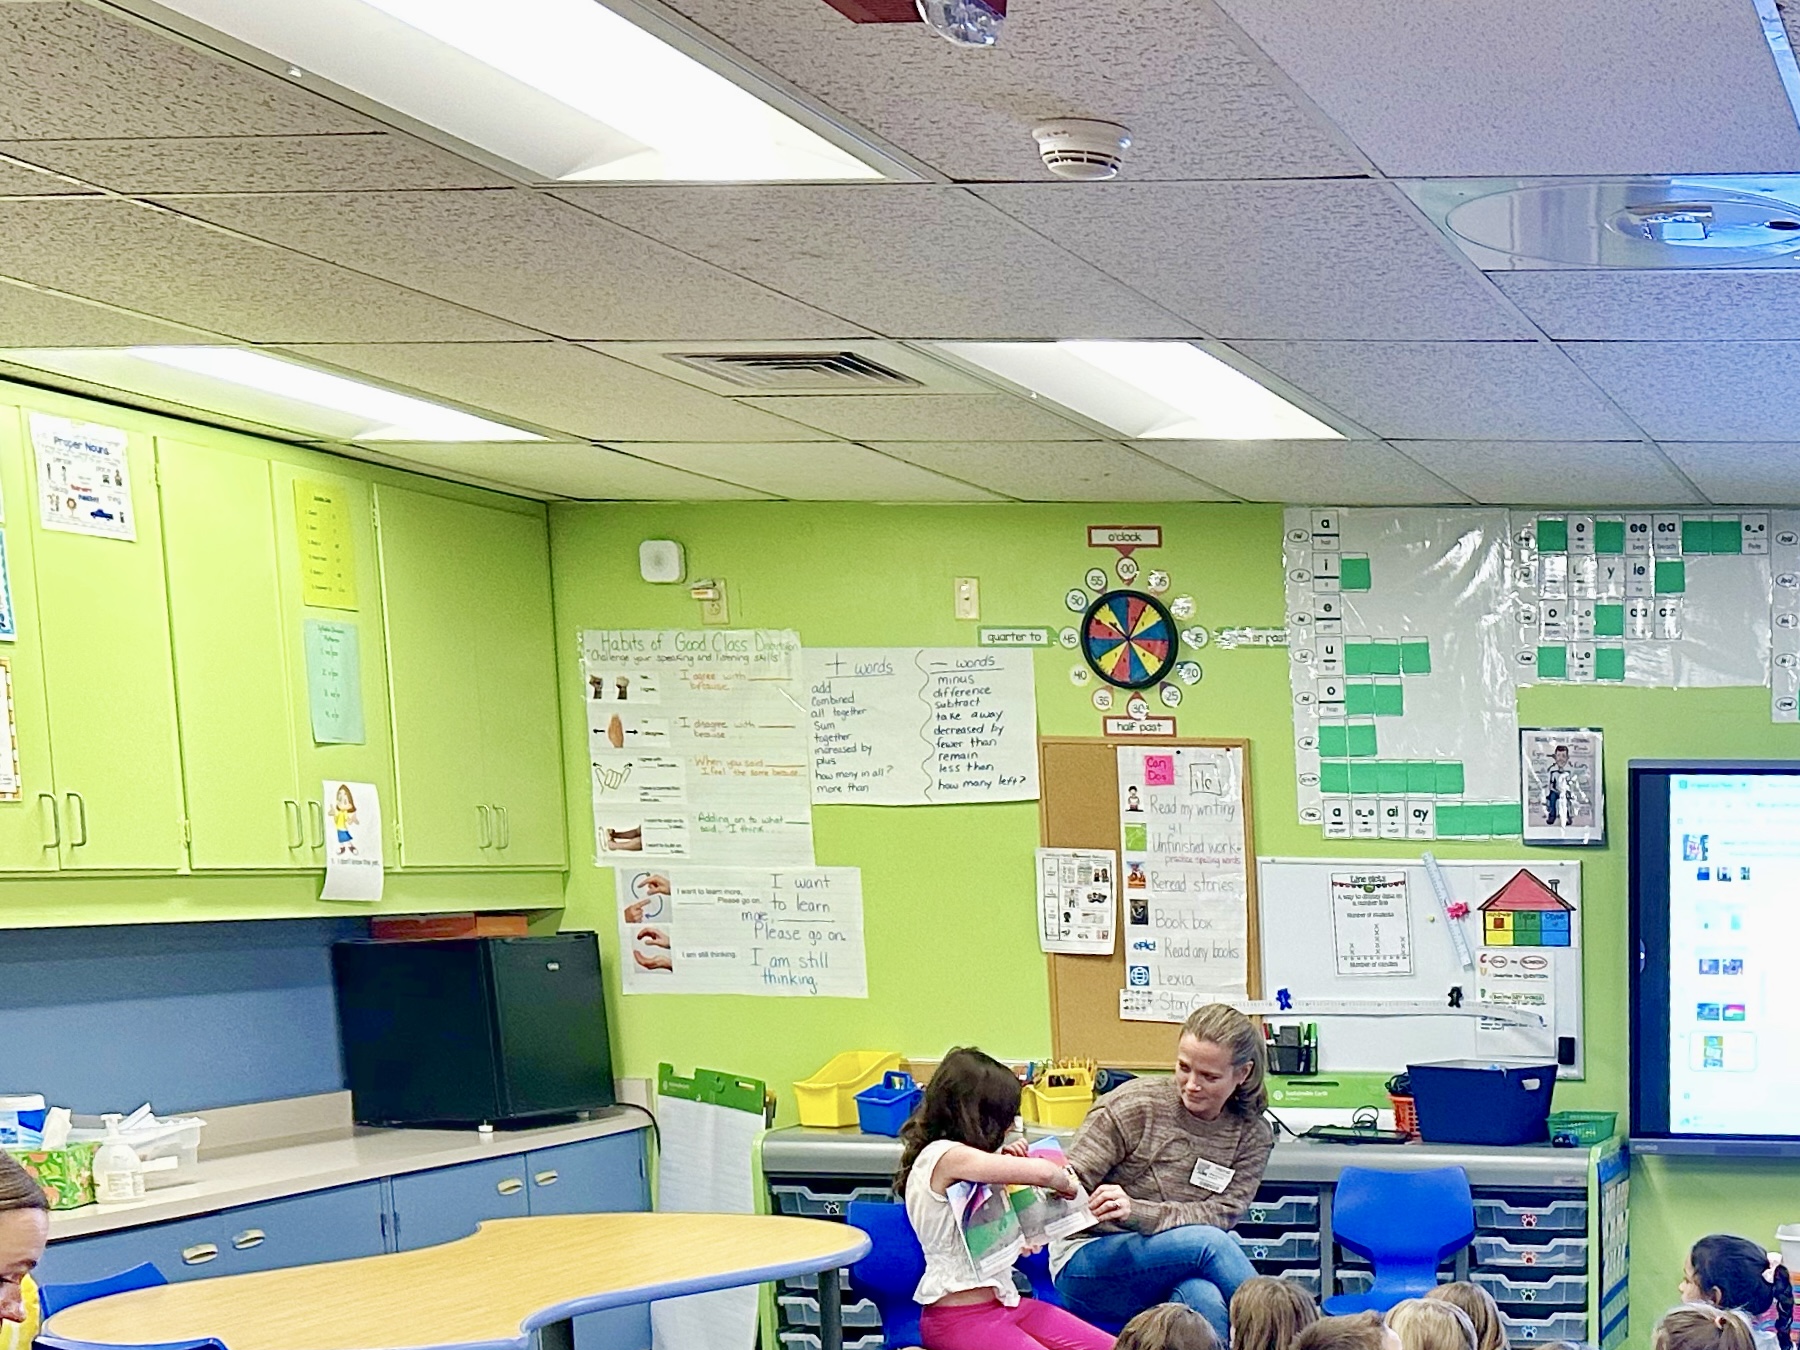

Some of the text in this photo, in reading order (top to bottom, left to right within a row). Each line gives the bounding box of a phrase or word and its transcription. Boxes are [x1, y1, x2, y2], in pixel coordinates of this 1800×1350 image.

[1630, 521, 1676, 533] ee ea
[1108, 531, 1142, 543] o'clock
[601, 631, 643, 650] Habits
[651, 633, 663, 650] of
[675, 632, 706, 651] Good
[712, 632, 748, 651] Class
[988, 632, 1042, 643] quarter to
[634, 651, 750, 667] your speaking and listening
[855, 655, 893, 675] words
[956, 655, 996, 668] words
[812, 680, 831, 693] add
[938, 674, 975, 685] minus
[811, 690, 855, 706] Combined
[933, 686, 992, 698] difference
[935, 697, 980, 709] subtract
[811, 707, 866, 721] all together
[936, 710, 1003, 721] take away
[814, 720, 835, 730] Sum
[934, 723, 1004, 736] decreased by
[1117, 721, 1163, 733] half past
[814, 732, 852, 746] together
[936, 737, 997, 748] fewer than
[815, 742, 872, 756] increased by
[938, 751, 978, 761] remain
[816, 757, 837, 768] plus
[939, 761, 994, 773] less than
[1146, 757, 1167, 768] Can
[815, 769, 858, 780] how many
[817, 783, 869, 793] more than
[938, 774, 1026, 790] how many left?
[1150, 794, 1235, 822] Read my writing
[1386, 805, 1429, 822] ai ay
[1152, 833, 1204, 853] Unfinished
[795, 874, 830, 889] want
[1151, 871, 1234, 892] Reread stories
[771, 892, 830, 912] to learn
[1155, 908, 1213, 929] Book box
[755, 921, 822, 946] Please go
[1164, 937, 1190, 958] Read
[1193, 947, 1208, 962] any
[1212, 940, 1239, 959] books
[769, 951, 829, 968] am still
[761, 968, 818, 995] thinking.
[1157, 965, 1194, 986] Lexia
[1160, 992, 1190, 1011] Story
